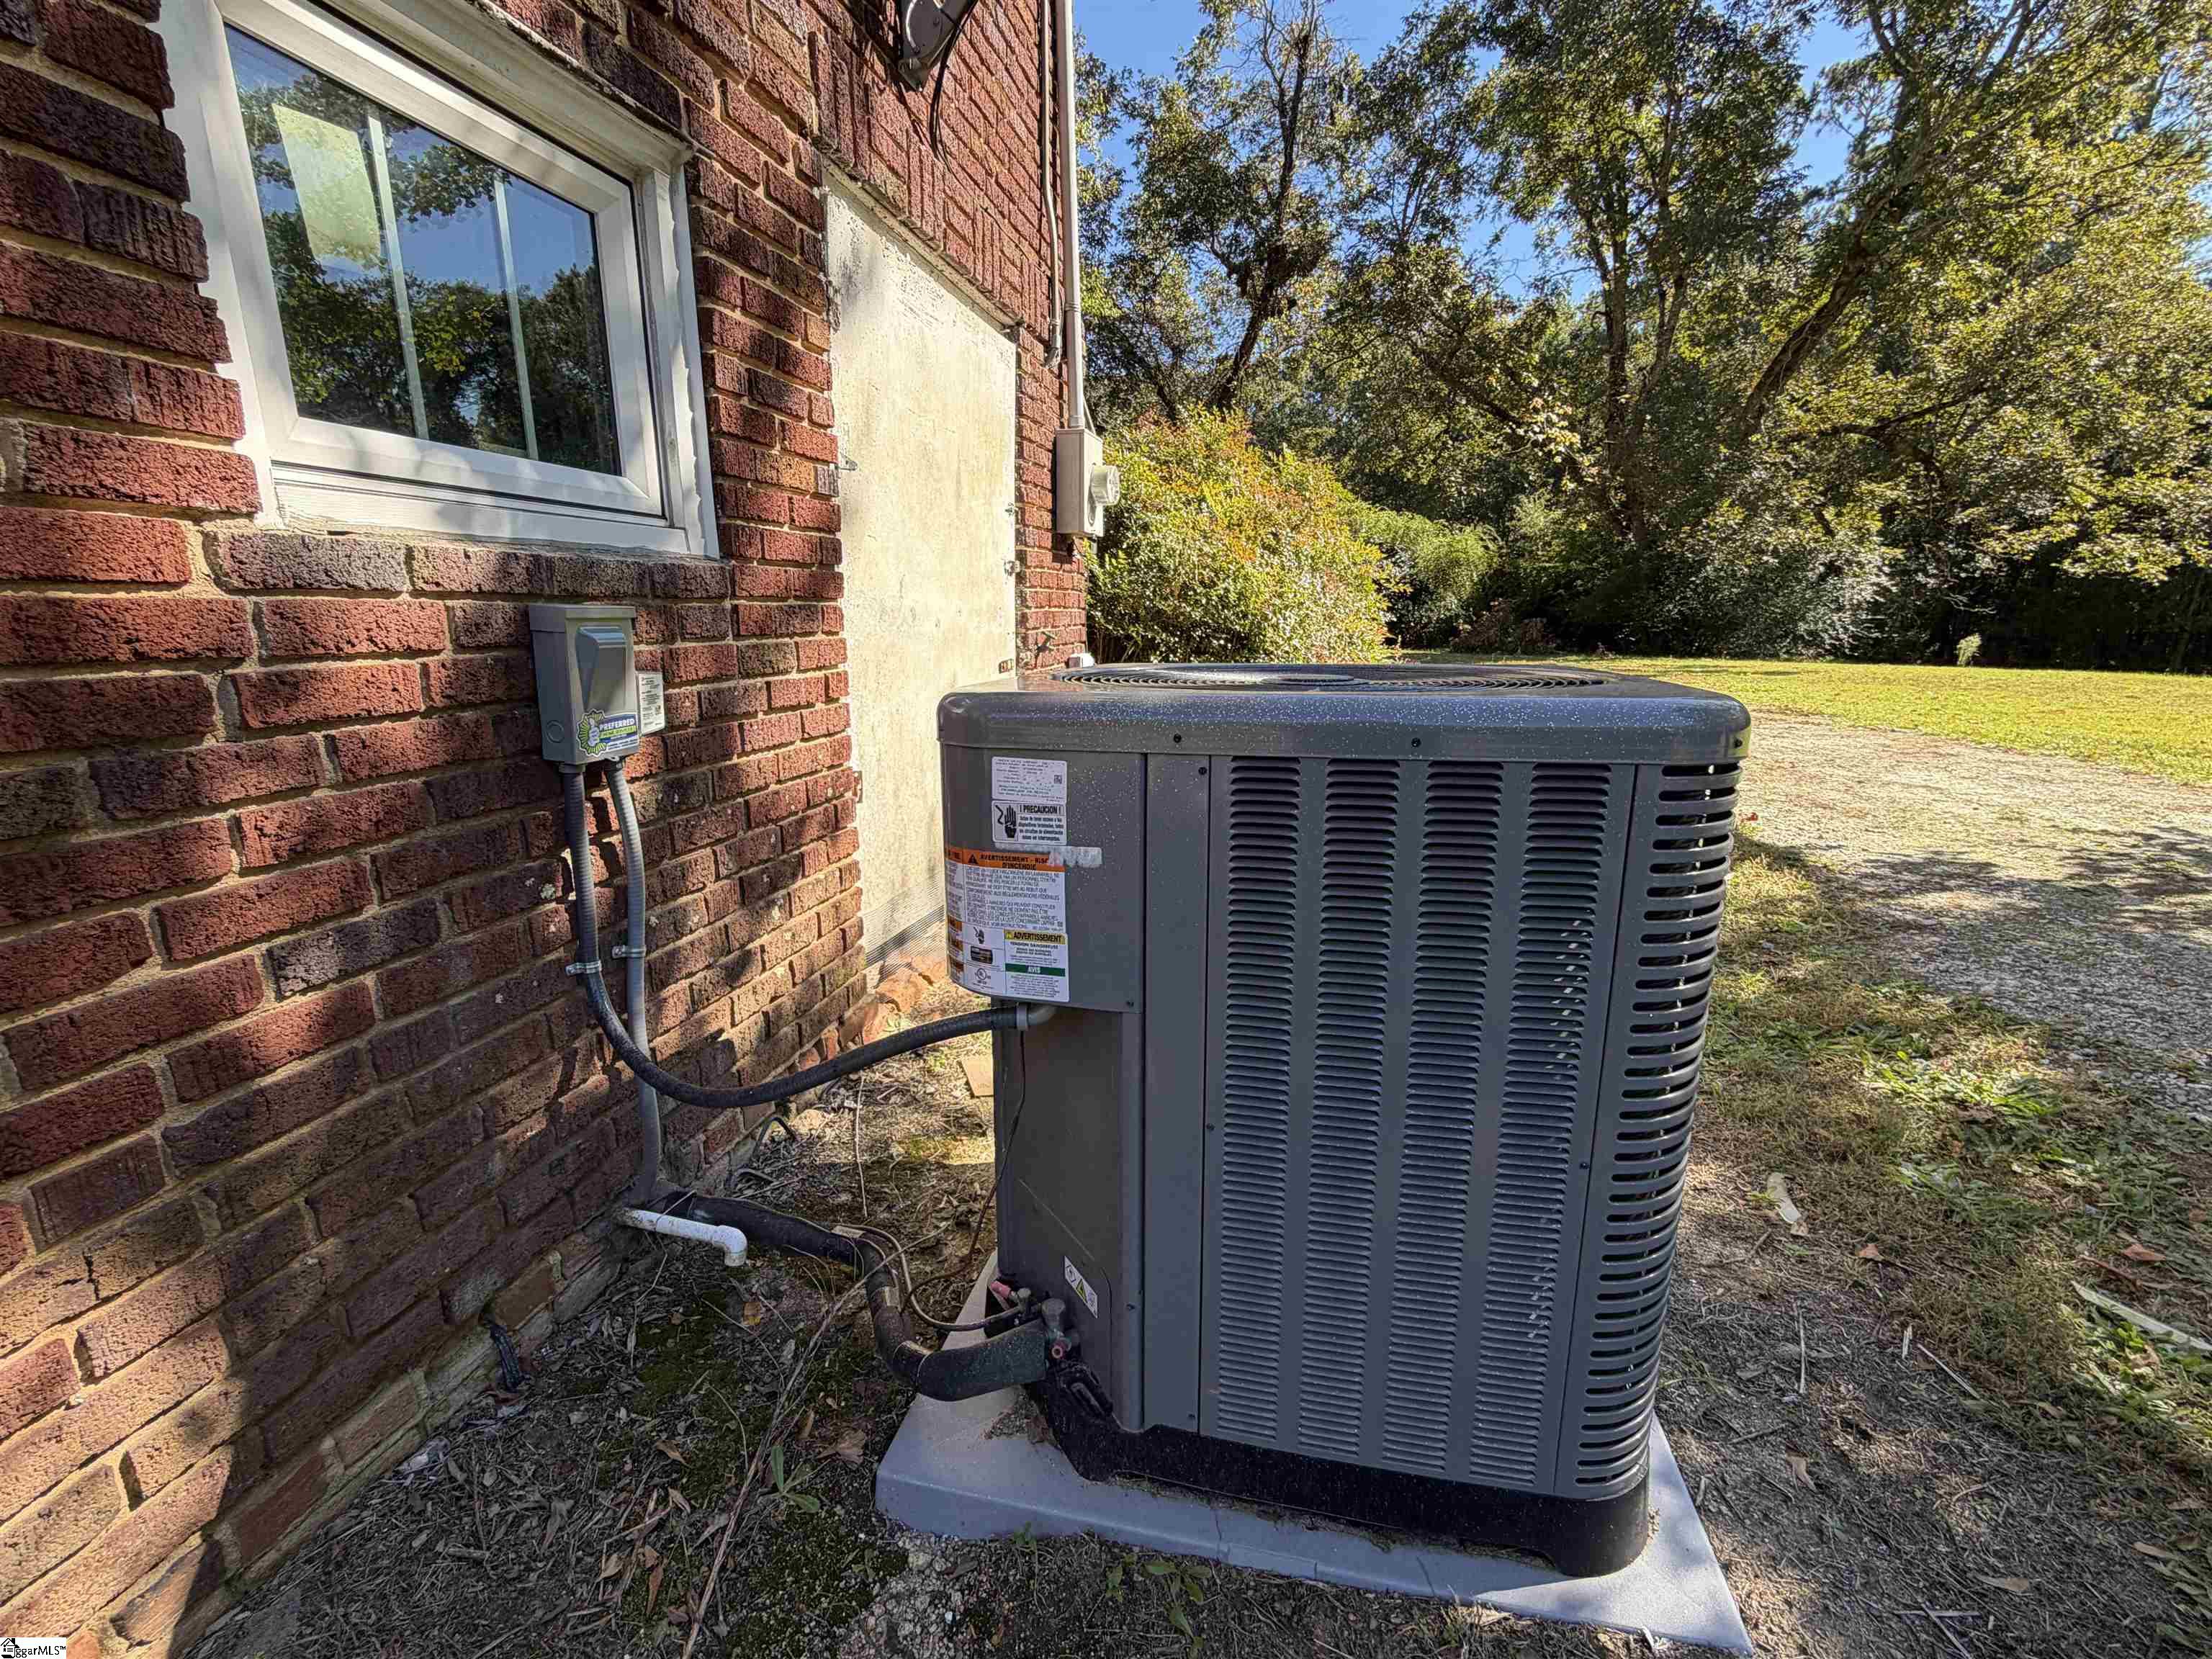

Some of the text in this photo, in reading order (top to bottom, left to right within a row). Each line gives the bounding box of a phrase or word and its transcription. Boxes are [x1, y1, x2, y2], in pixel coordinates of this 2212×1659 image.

[599, 719, 634, 731] PREFERRED
[1023, 805, 1058, 814] PRECAUCION
[979, 854, 1030, 863] AVERTISSEMENT
